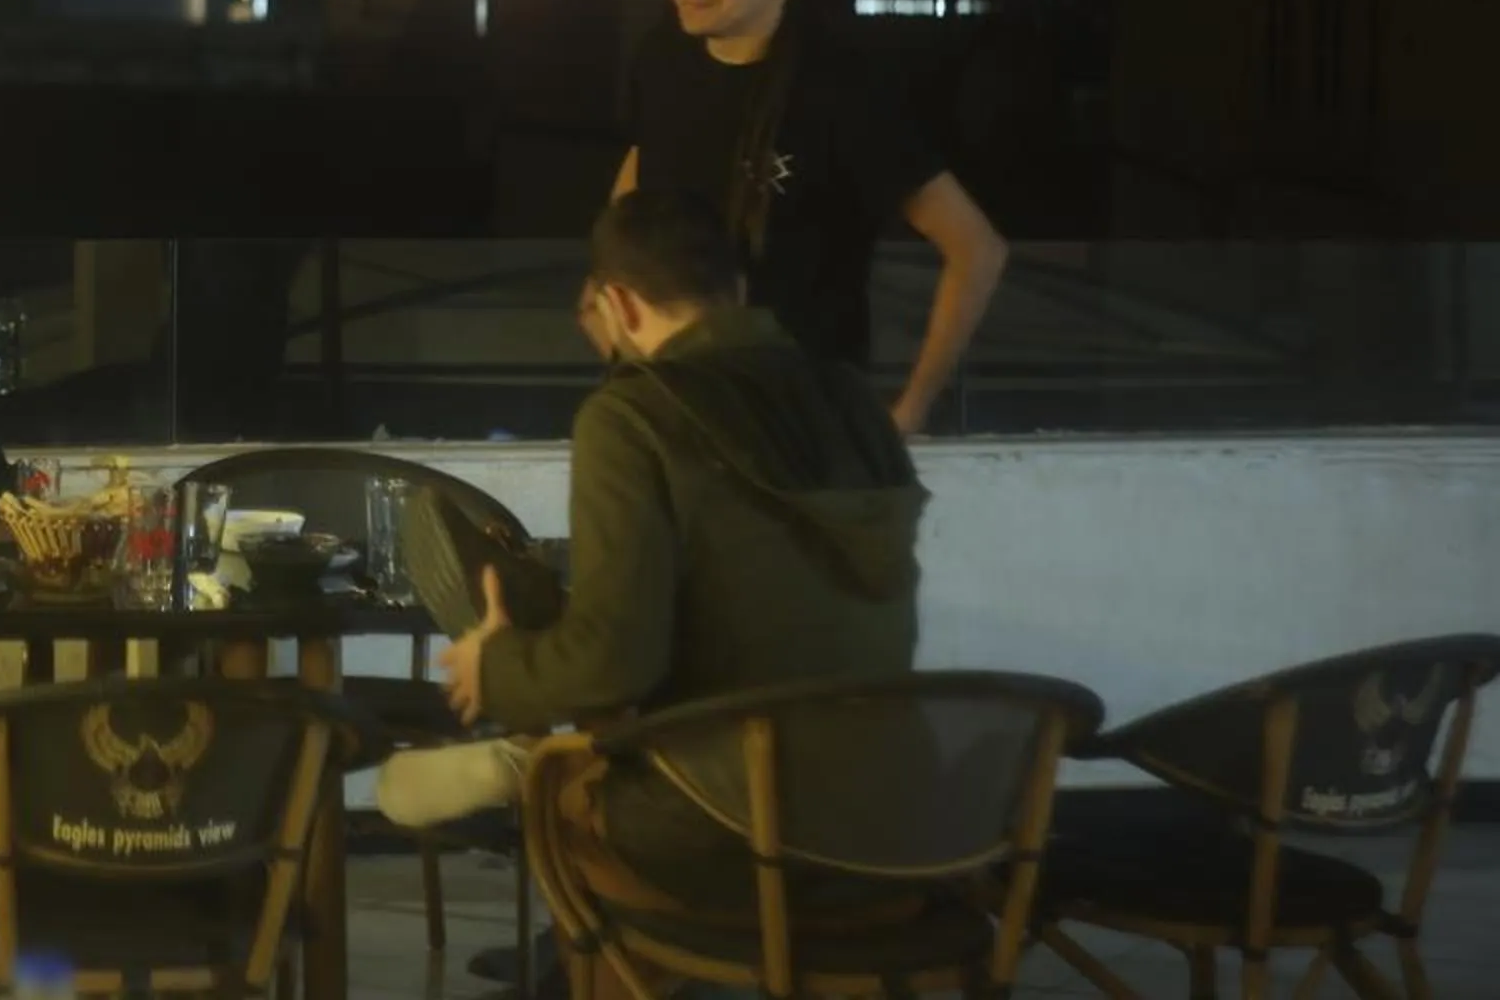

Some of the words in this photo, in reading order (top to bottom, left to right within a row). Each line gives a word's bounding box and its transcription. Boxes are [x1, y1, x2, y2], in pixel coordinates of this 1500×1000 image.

[52, 813, 105, 850] Eagles
[112, 823, 191, 855] pyramids
[197, 818, 237, 846] view
